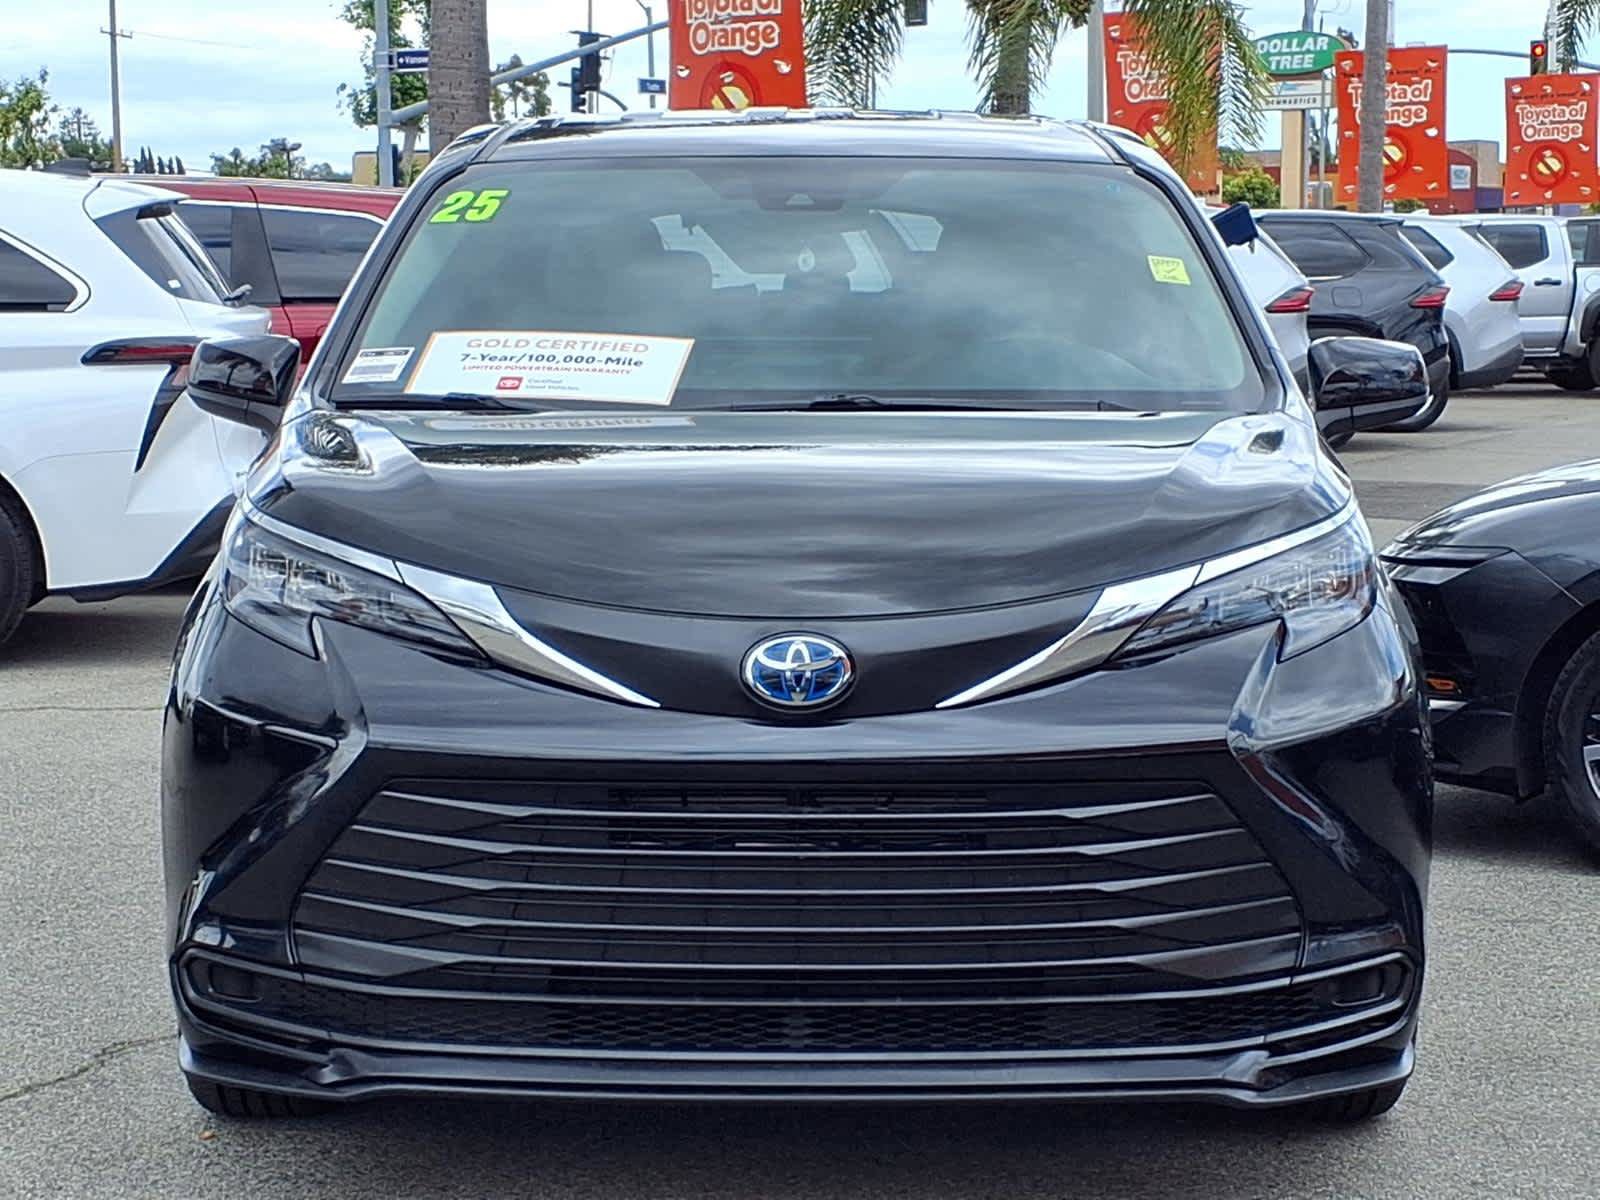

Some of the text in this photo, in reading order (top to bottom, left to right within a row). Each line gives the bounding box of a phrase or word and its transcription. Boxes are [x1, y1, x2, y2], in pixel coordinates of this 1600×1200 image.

[690, 20, 779, 55] Orange
[1257, 36, 1329, 54] DOLLAR
[1268, 54, 1315, 70] TREE
[1348, 79, 1432, 107] Tota of
[1355, 105, 1428, 128] nge
[1515, 101, 1588, 126] Toyota of
[1521, 123, 1583, 142] Orange
[428, 189, 510, 223] 25
[466, 338, 649, 353] GOLD CERTIFIED
[460, 351, 644, 367] 7-Year/100,000-Mile
[503, 364, 572, 373] POWERTRAIN
[573, 366, 632, 375] WARRANTY
